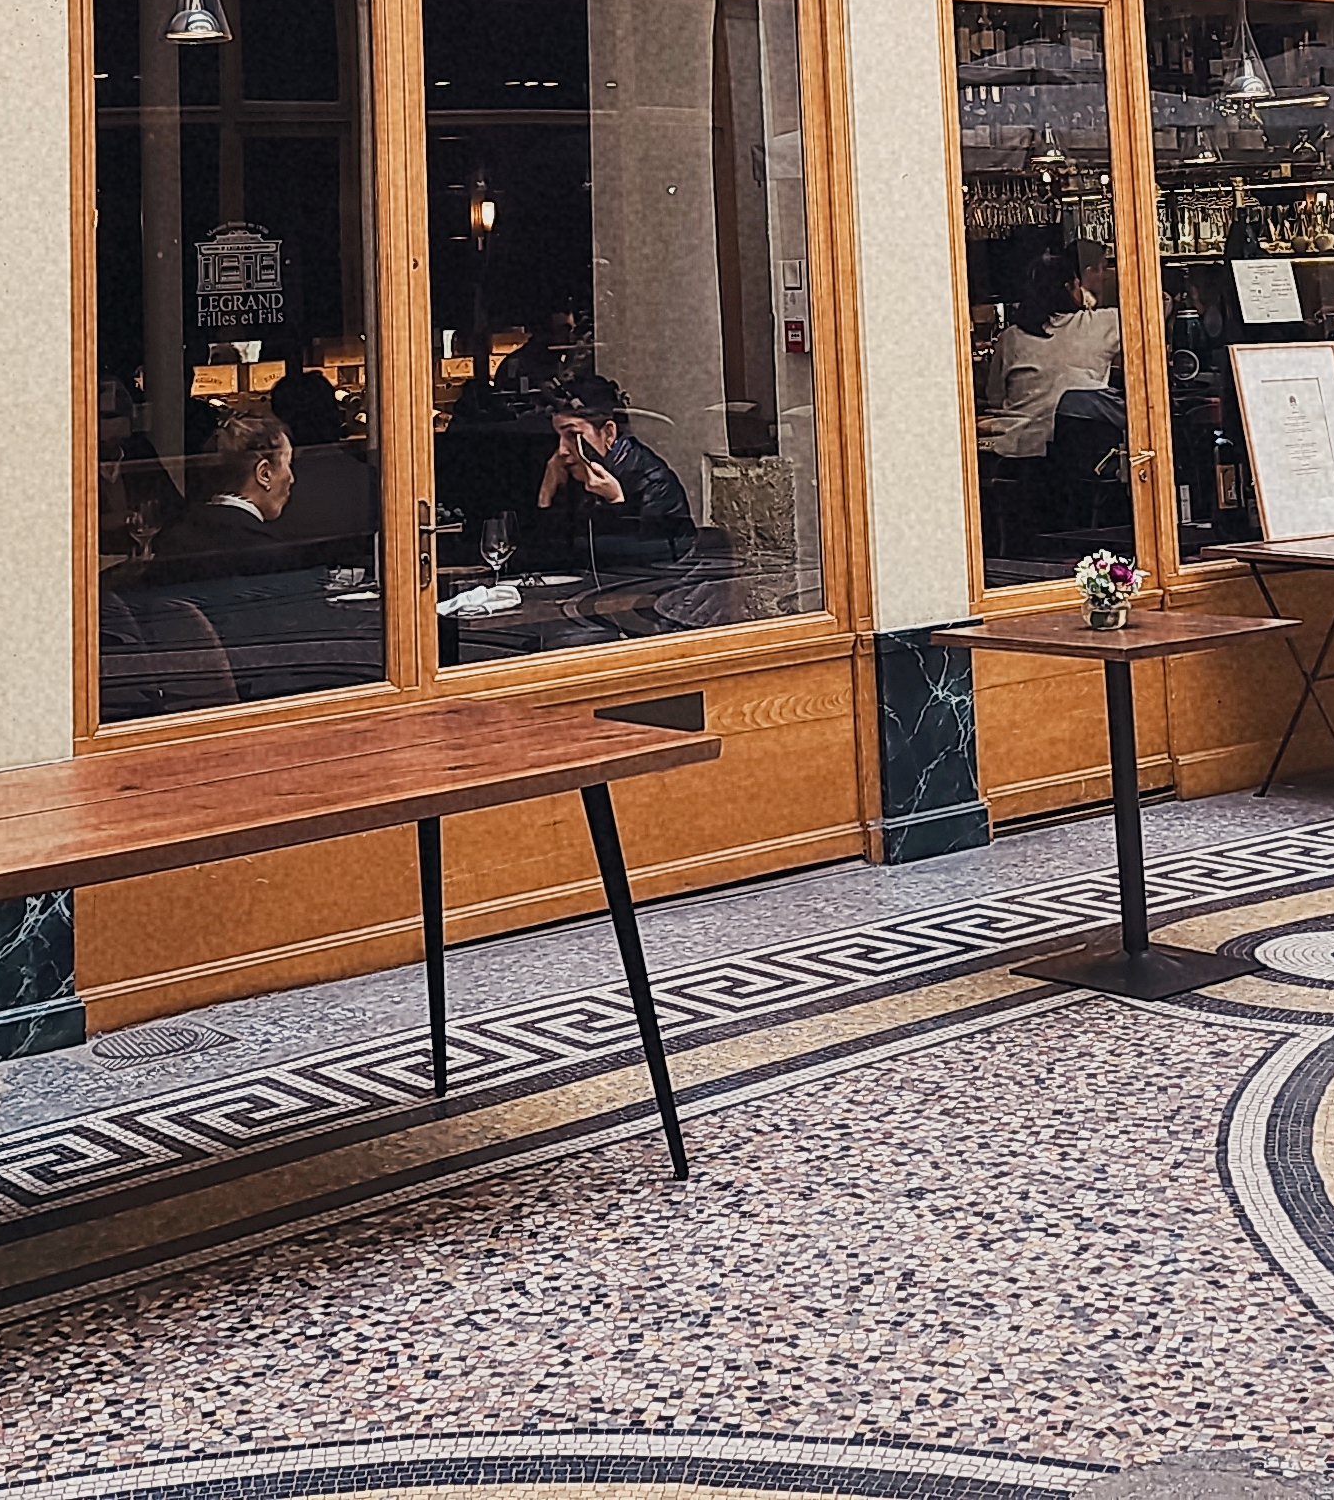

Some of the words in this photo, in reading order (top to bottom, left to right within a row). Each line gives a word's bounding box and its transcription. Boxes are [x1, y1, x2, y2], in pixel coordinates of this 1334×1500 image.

[197, 292, 284, 313] LEGRAND
[197, 310, 237, 327] Filles
[240, 312, 254, 325] et
[258, 308, 284, 324] Fils
